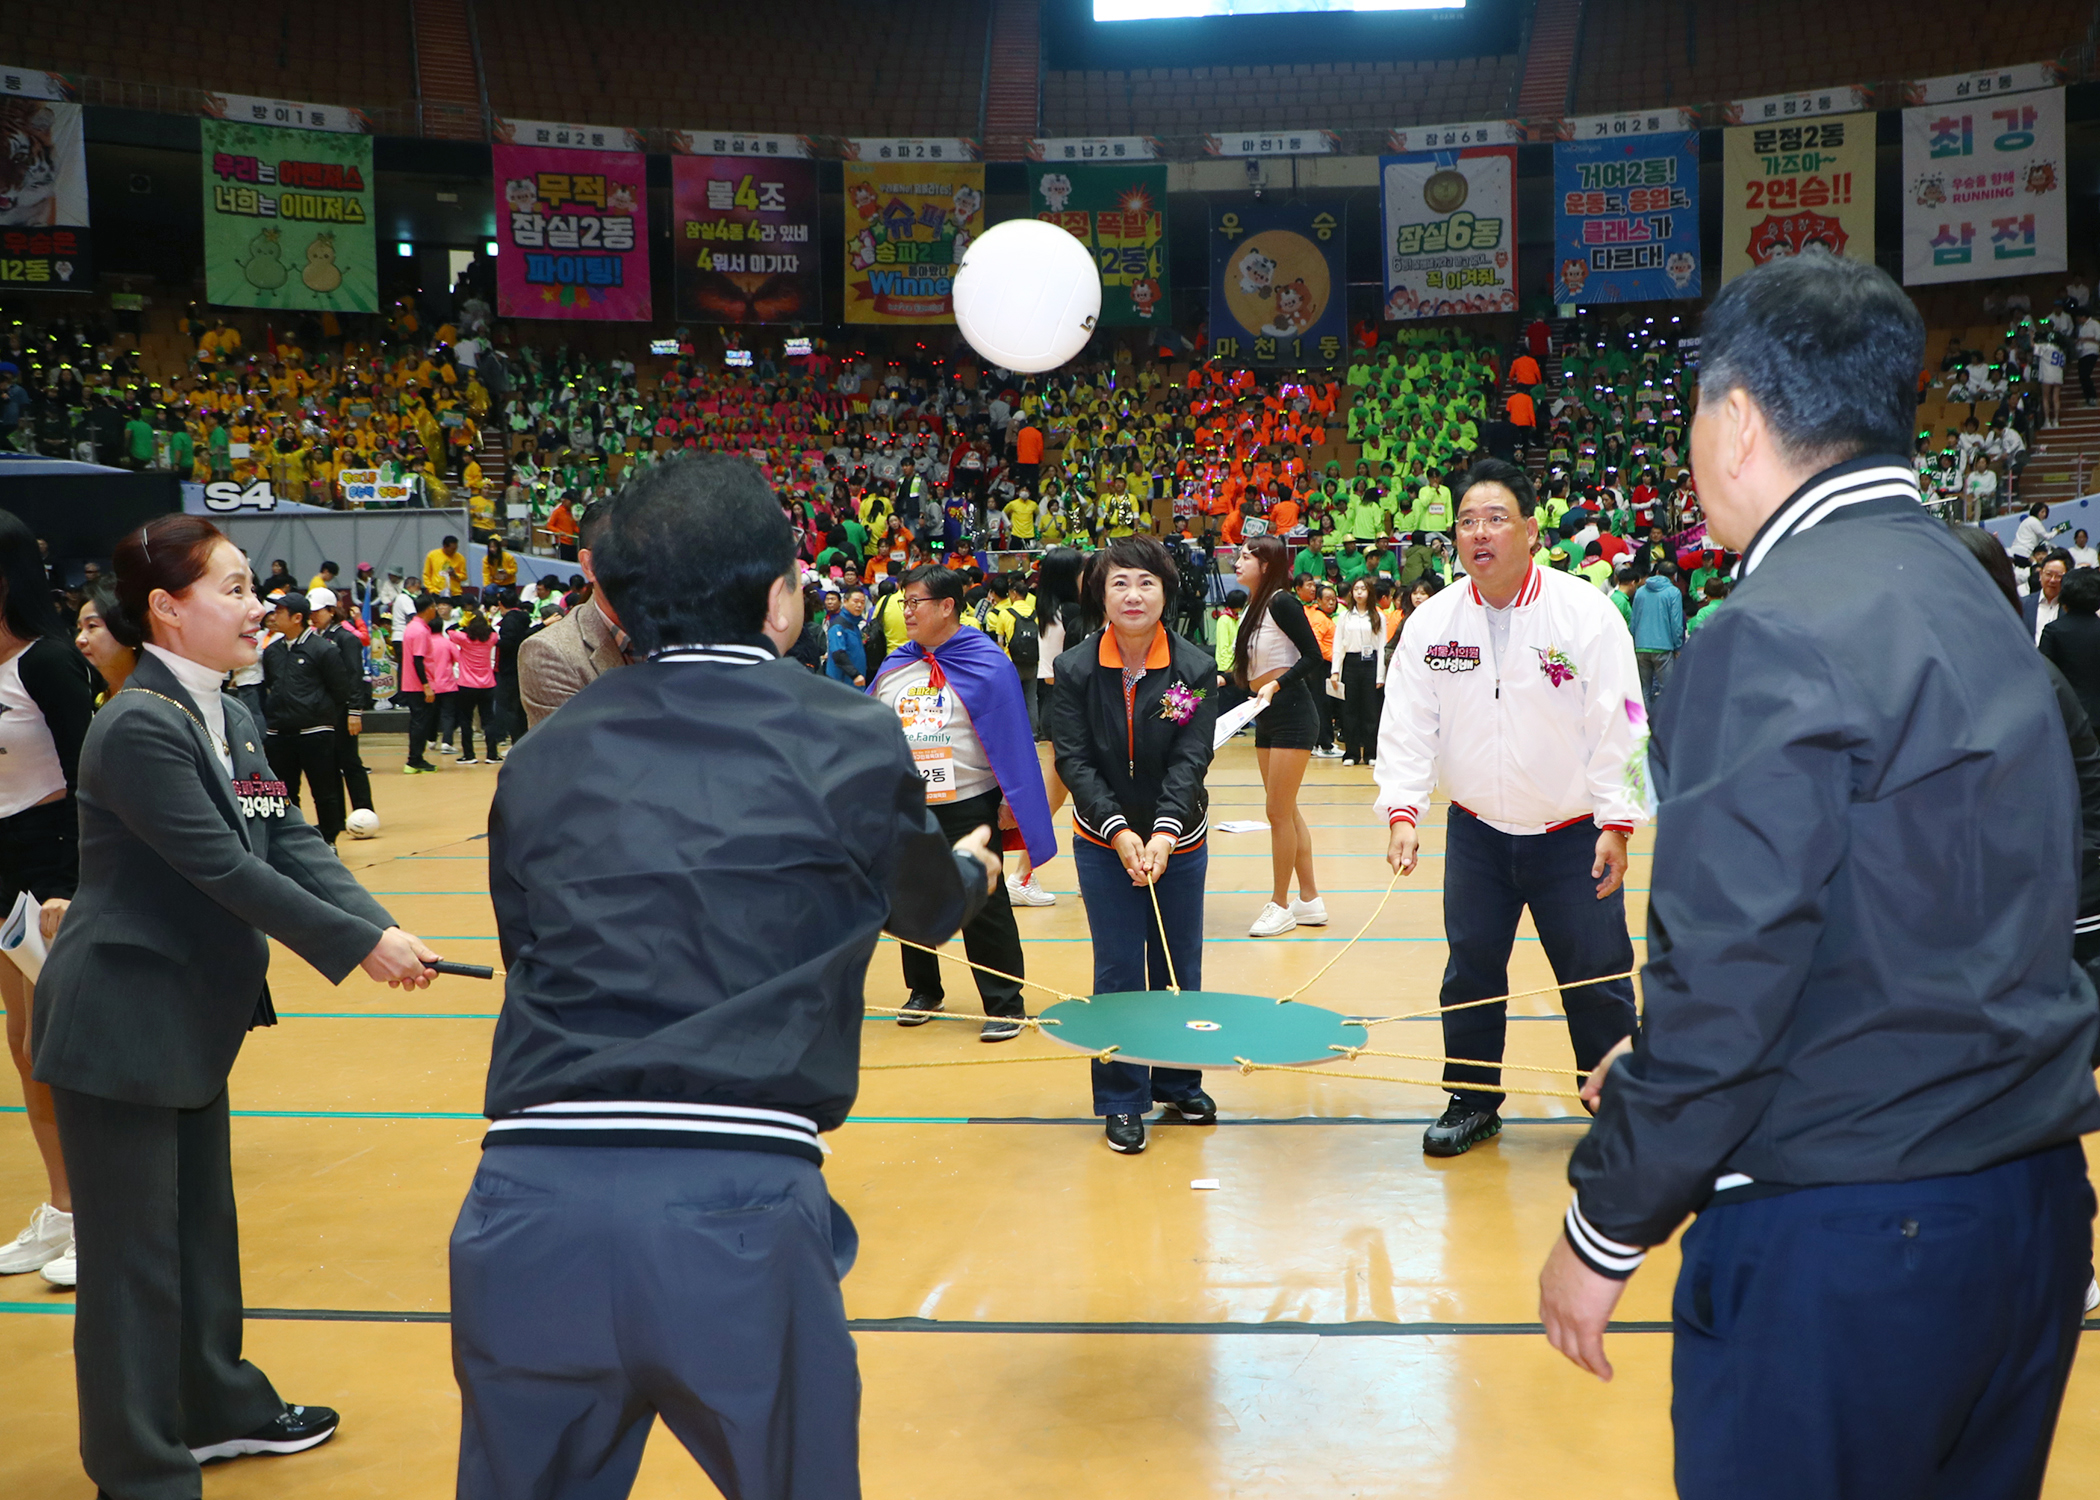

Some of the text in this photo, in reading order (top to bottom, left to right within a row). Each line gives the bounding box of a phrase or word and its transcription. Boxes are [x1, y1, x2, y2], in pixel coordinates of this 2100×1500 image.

[1754, 123, 1844, 154] 문정2동
[214, 153, 276, 186] 우리는
[1577, 157, 1677, 189] 거여2동!
[1761, 152, 1836, 175] 가즈아~
[536, 172, 607, 211] 무적
[707, 174, 786, 212] 불4조
[1746, 172, 1851, 209] 2연승!!
[1952, 171, 2014, 191] 우승을 향해
[1953, 187, 2014, 203] RUNNING
[215, 186, 276, 217] 너희는
[1565, 186, 1691, 216] 운동도, 응원도,
[511, 212, 634, 251] 잠실2동
[686, 218, 808, 242] 잠실4동 4라 있네
[883, 197, 947, 239] 슈퍼
[1097, 211, 1162, 239] 폭발!
[1583, 214, 1673, 244] 클래스가
[4, 232, 77, 254] 우승은
[1398, 211, 1502, 256] 잠실6동
[697, 247, 799, 273] 4워서 이기자
[875, 241, 953, 264] 송파2동
[1591, 243, 1664, 272] 다르다!
[525, 254, 623, 287] 파이팅!
[1426, 271, 1443, 288] 꼭
[205, 481, 276, 511] S4
[1426, 646, 1479, 658] 서울시의원
[1430, 657, 1474, 672] 이성배
[908, 686, 938, 697] 송파2동
[917, 767, 946, 783] 2동
[237, 796, 286, 818] 김영심
